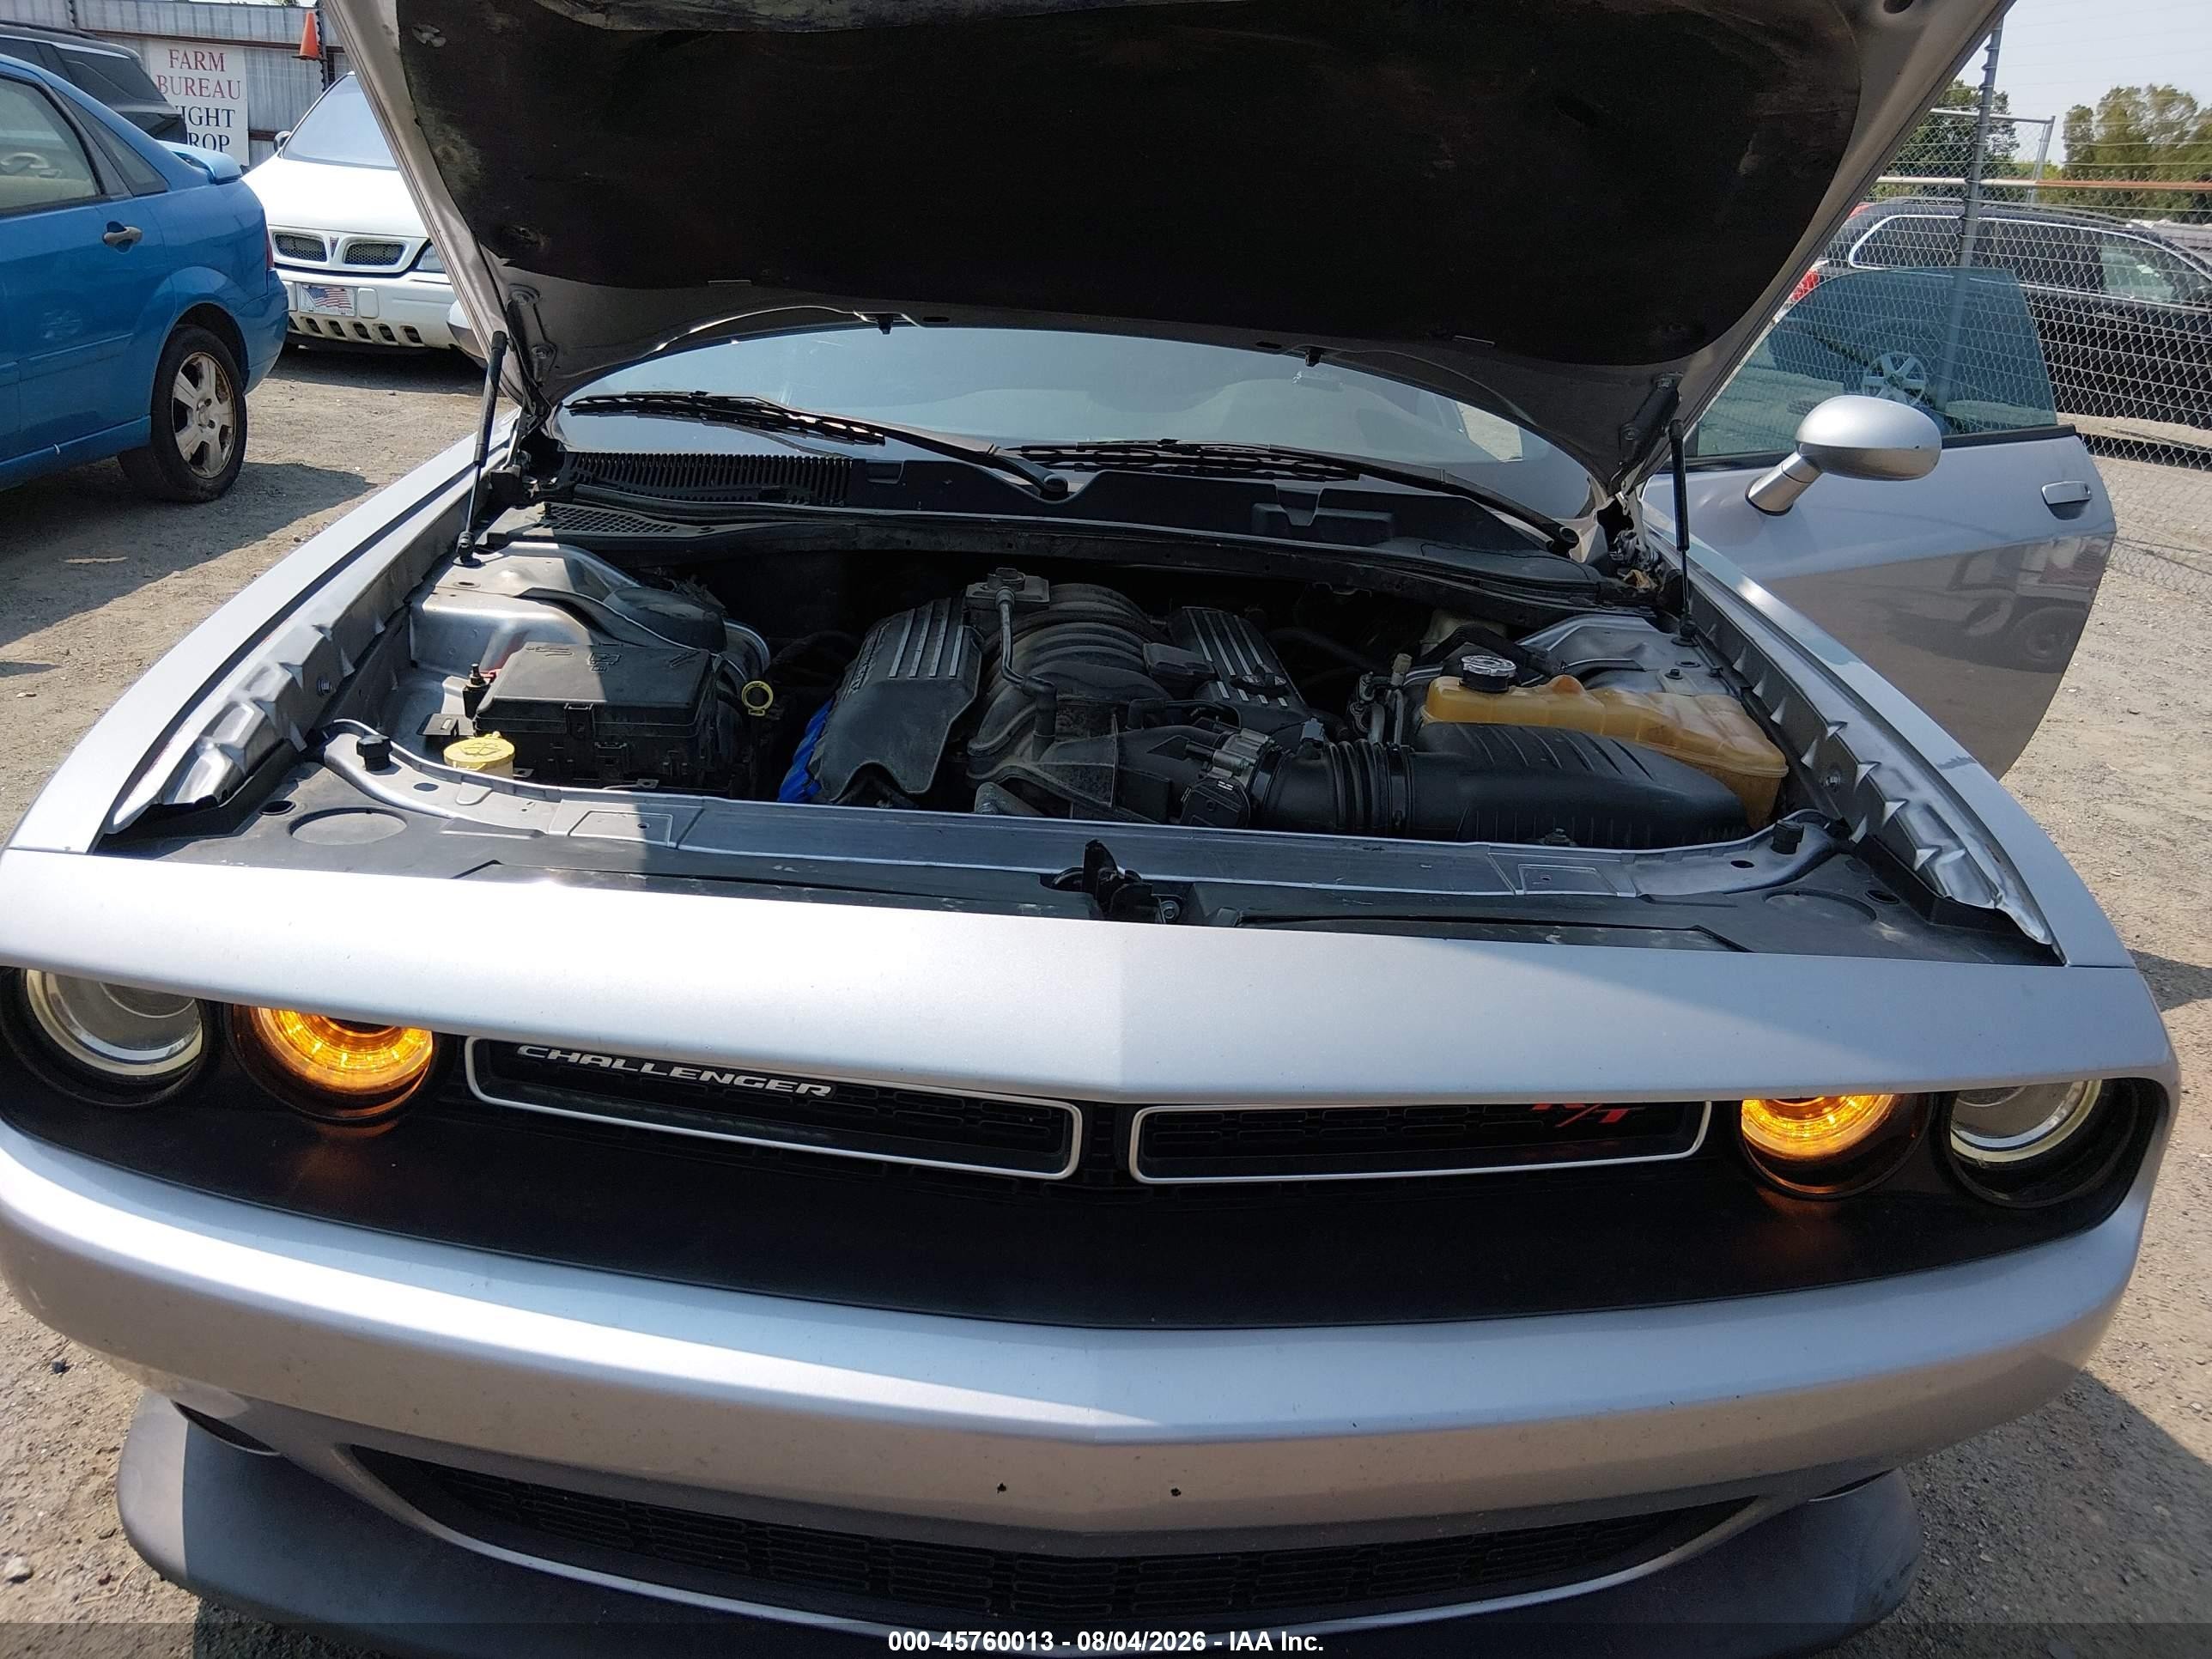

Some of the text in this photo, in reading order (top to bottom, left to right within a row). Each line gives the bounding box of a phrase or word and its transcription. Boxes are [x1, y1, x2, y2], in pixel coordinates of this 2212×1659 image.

[168, 49, 225, 72] FARM
[156, 75, 240, 100] BUREAU
[174, 106, 236, 128] IGHT
[517, 1045, 832, 1097] CHALLENGER
